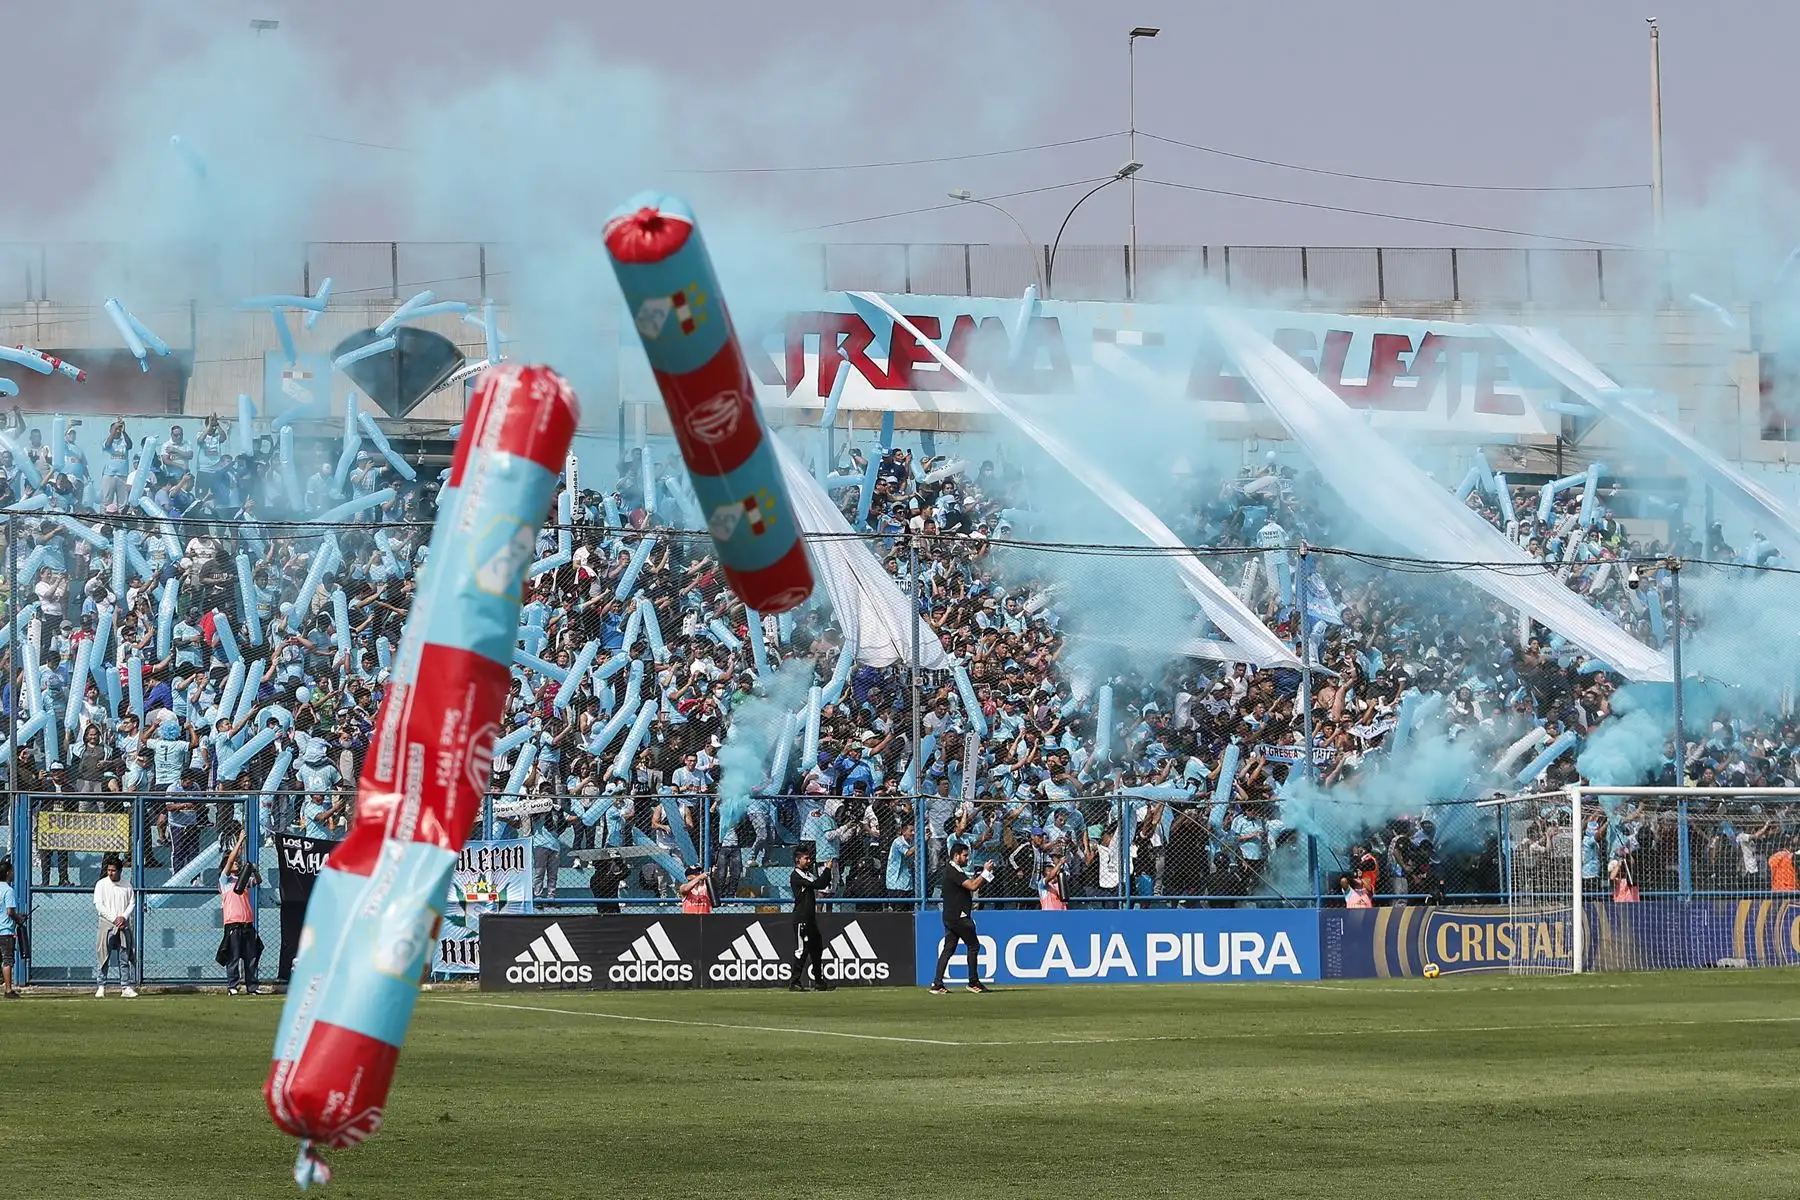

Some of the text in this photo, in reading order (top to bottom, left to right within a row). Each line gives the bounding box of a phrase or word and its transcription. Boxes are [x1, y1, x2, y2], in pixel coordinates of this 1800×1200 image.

[436, 750, 454, 787] 1924
[283, 837, 302, 848] LOS
[1436, 921, 1571, 962] CRISTAL
[1005, 933, 1138, 978] CAJA
[1147, 931, 1302, 977] PIURA
[506, 961, 593, 983] adidas
[608, 960, 694, 983] adidas
[709, 959, 792, 982] adidas
